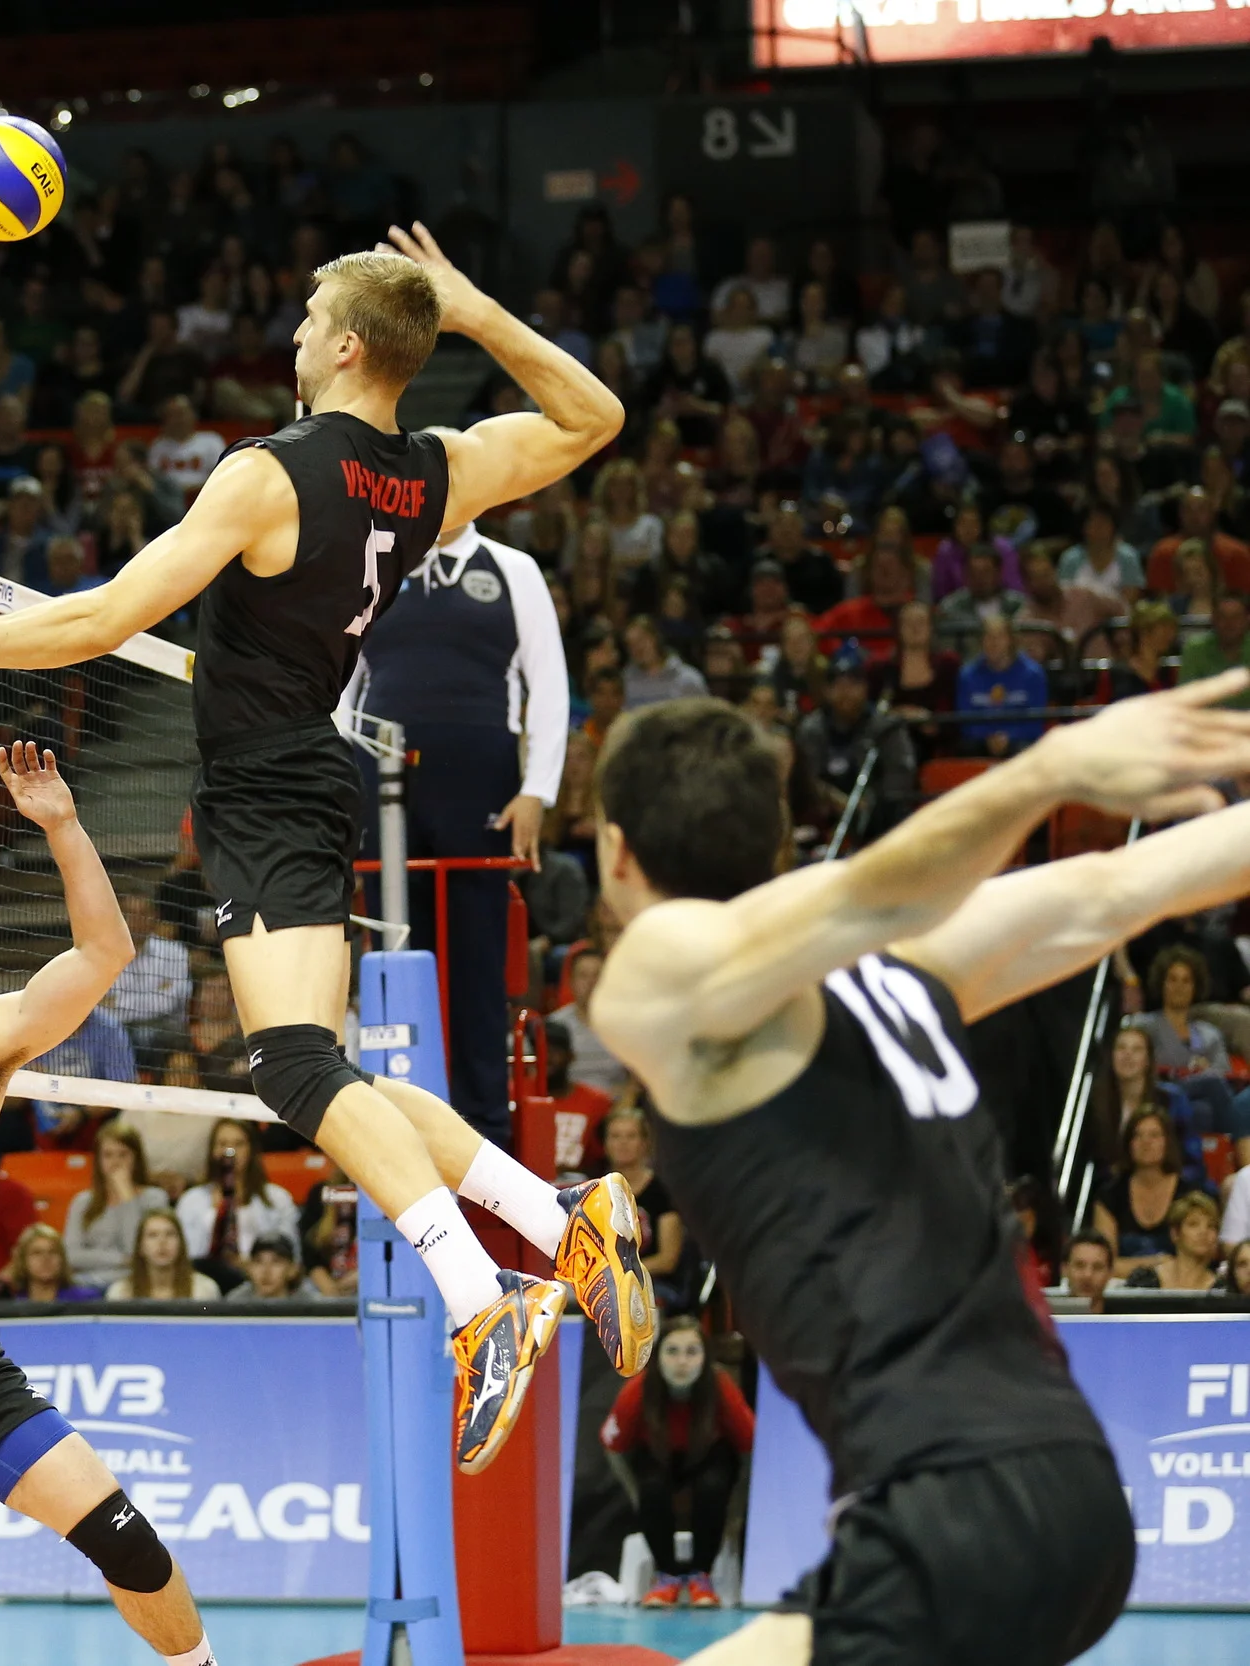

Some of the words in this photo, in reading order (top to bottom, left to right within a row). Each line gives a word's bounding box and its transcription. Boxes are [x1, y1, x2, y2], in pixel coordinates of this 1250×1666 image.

[703, 107, 739, 160] 8
[31, 162, 55, 198] FIVB
[0, 582, 14, 602] FIVB
[25, 1363, 166, 1416] FIVB
[1150, 1452, 1250, 1478] VOLL
